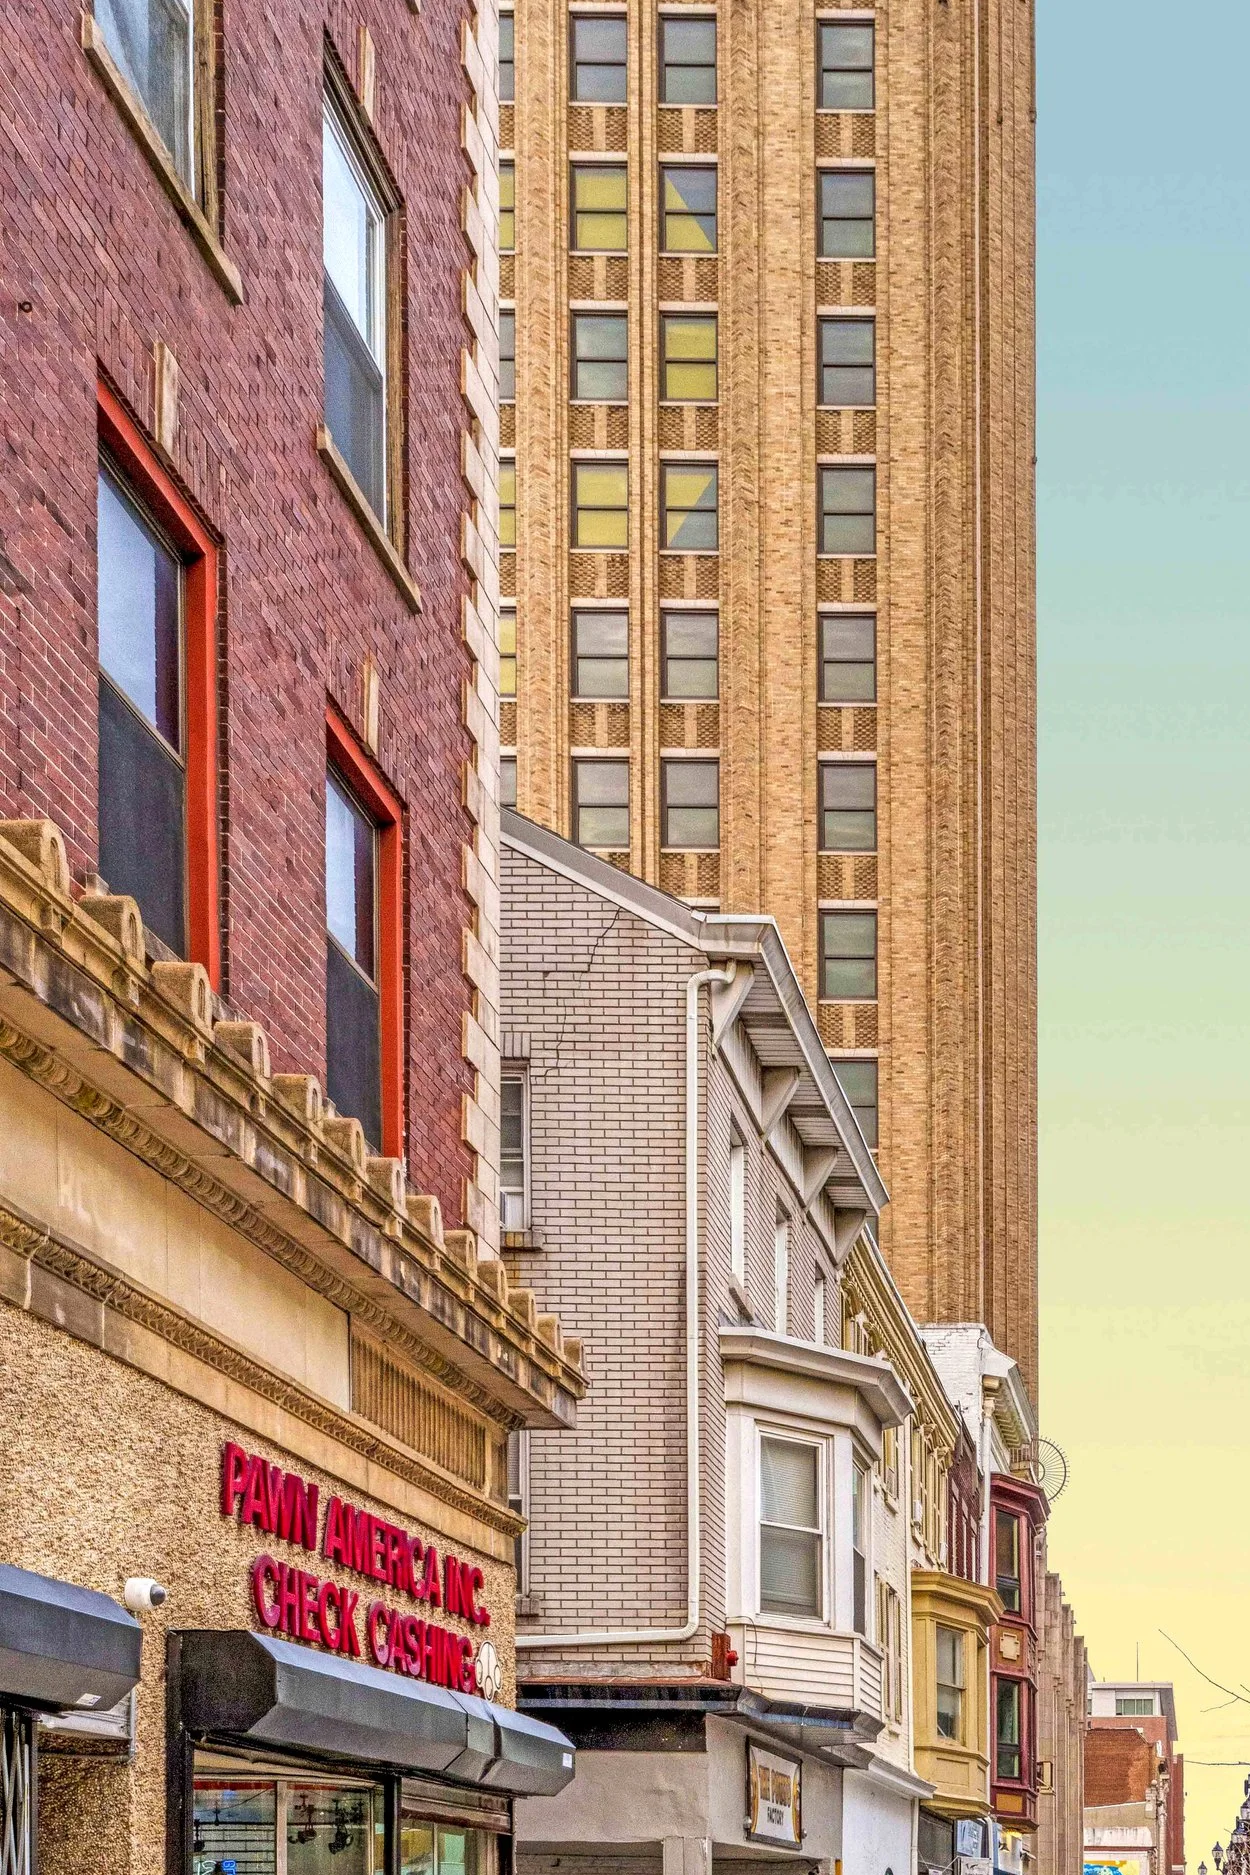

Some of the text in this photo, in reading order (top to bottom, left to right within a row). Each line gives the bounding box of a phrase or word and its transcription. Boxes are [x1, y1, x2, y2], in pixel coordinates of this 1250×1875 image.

[221, 1442, 491, 1627] PAWN AMERICA INC.
[252, 1554, 477, 1694] CHECK CASHING
[767, 1807, 784, 1827] FACTORY
